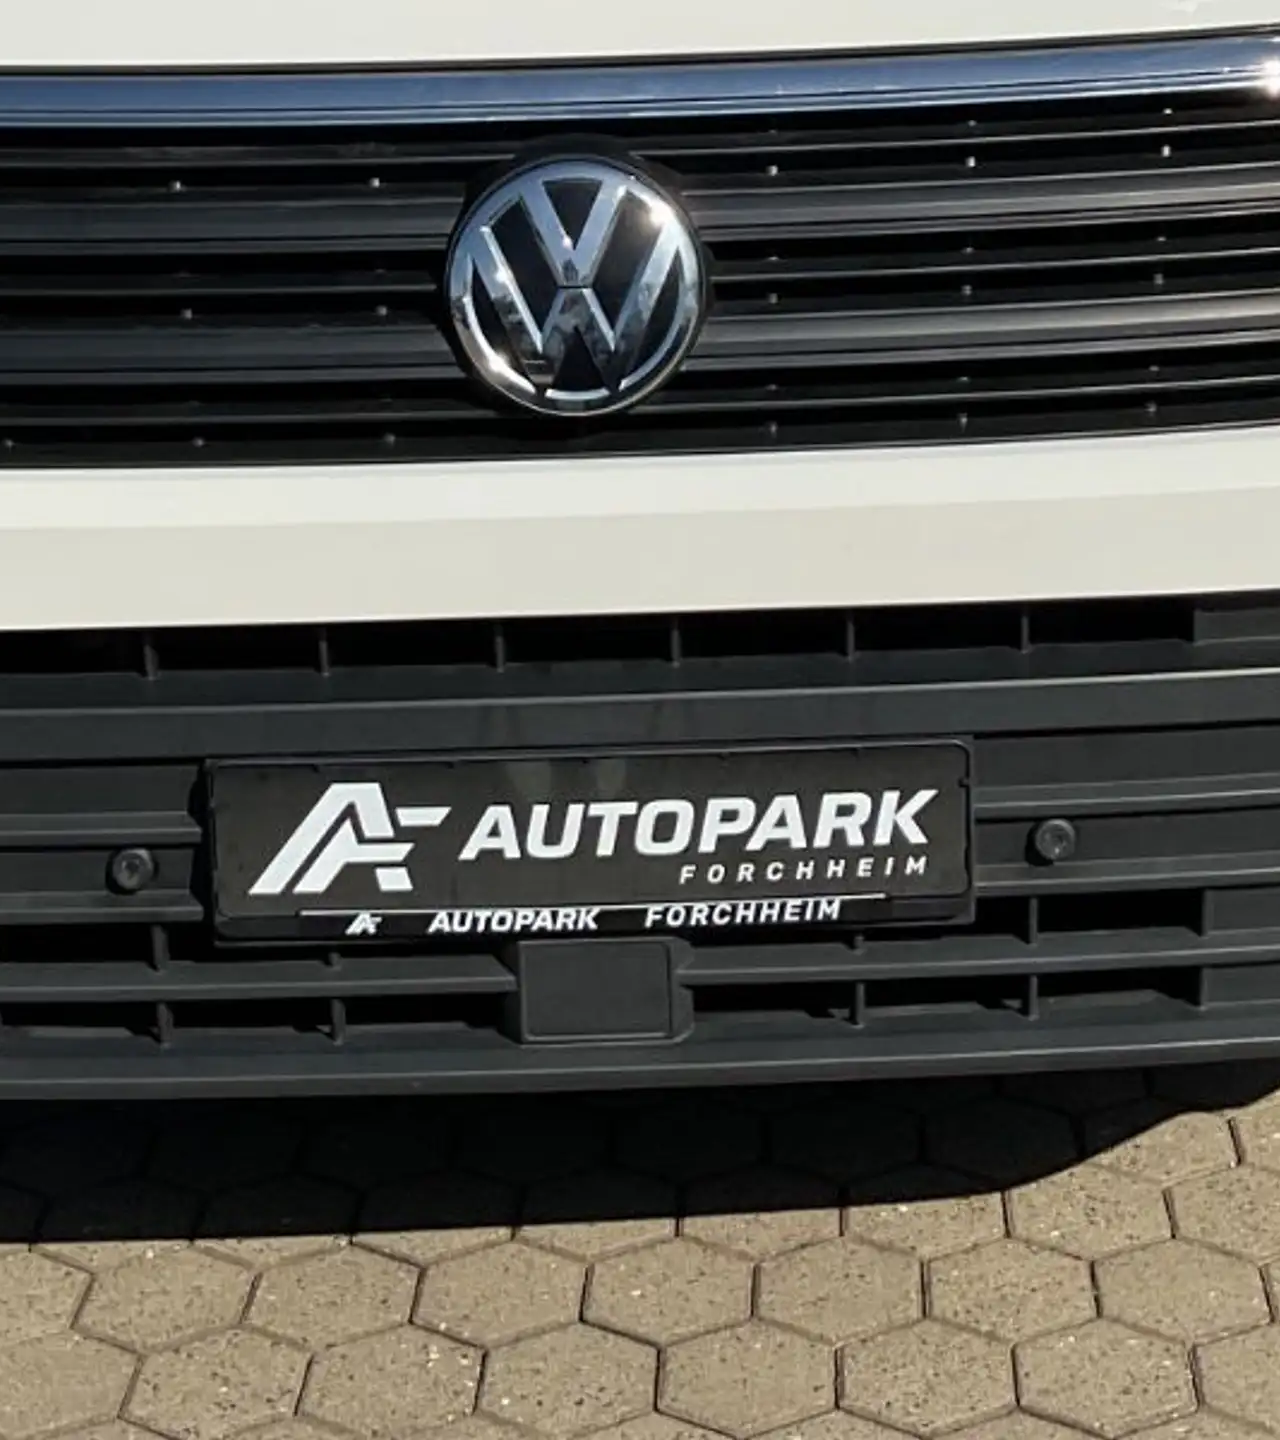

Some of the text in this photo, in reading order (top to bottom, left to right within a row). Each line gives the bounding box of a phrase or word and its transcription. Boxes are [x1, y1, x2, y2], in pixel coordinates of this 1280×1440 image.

[457, 788, 940, 861] AUTOPARK
[679, 855, 928, 885] FORCHHEIM
[427, 908, 600, 935] AUTOPARK
[644, 898, 842, 927] FORCHHEIM
